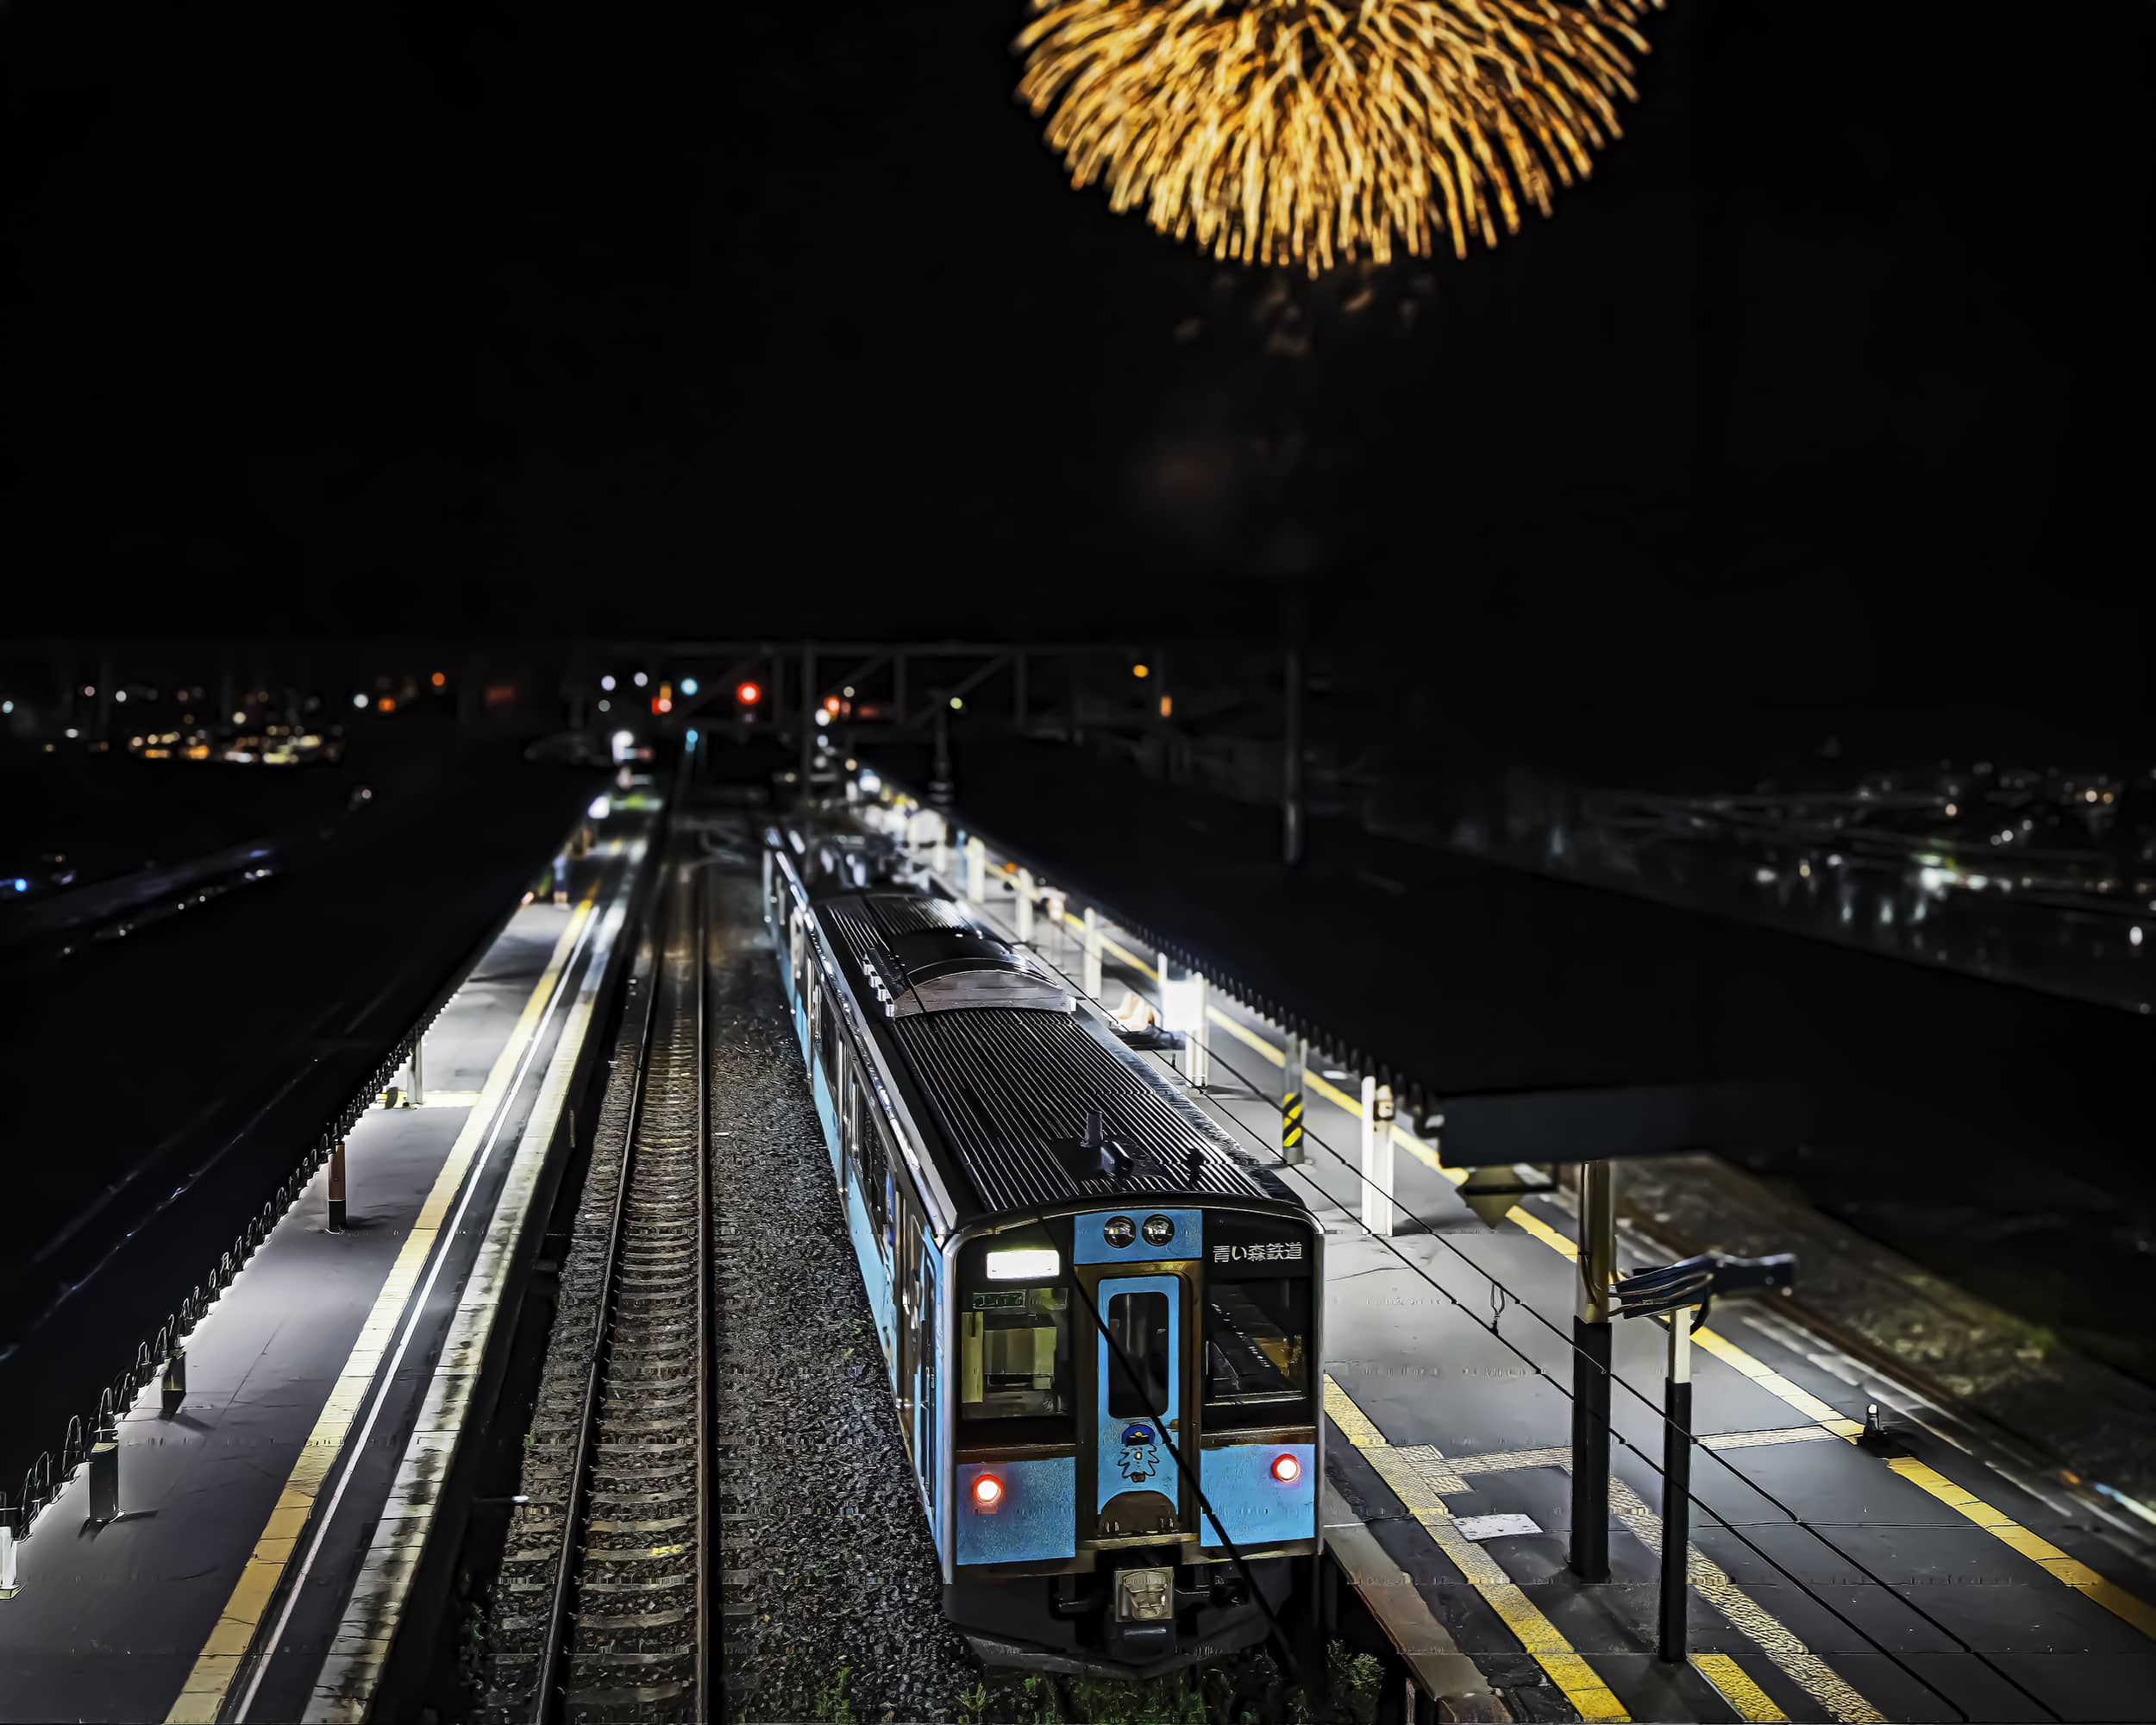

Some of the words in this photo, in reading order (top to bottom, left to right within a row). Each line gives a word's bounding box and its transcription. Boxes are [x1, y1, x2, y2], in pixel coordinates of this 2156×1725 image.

[1213, 1242, 1303, 1263] 青い森鉄道
